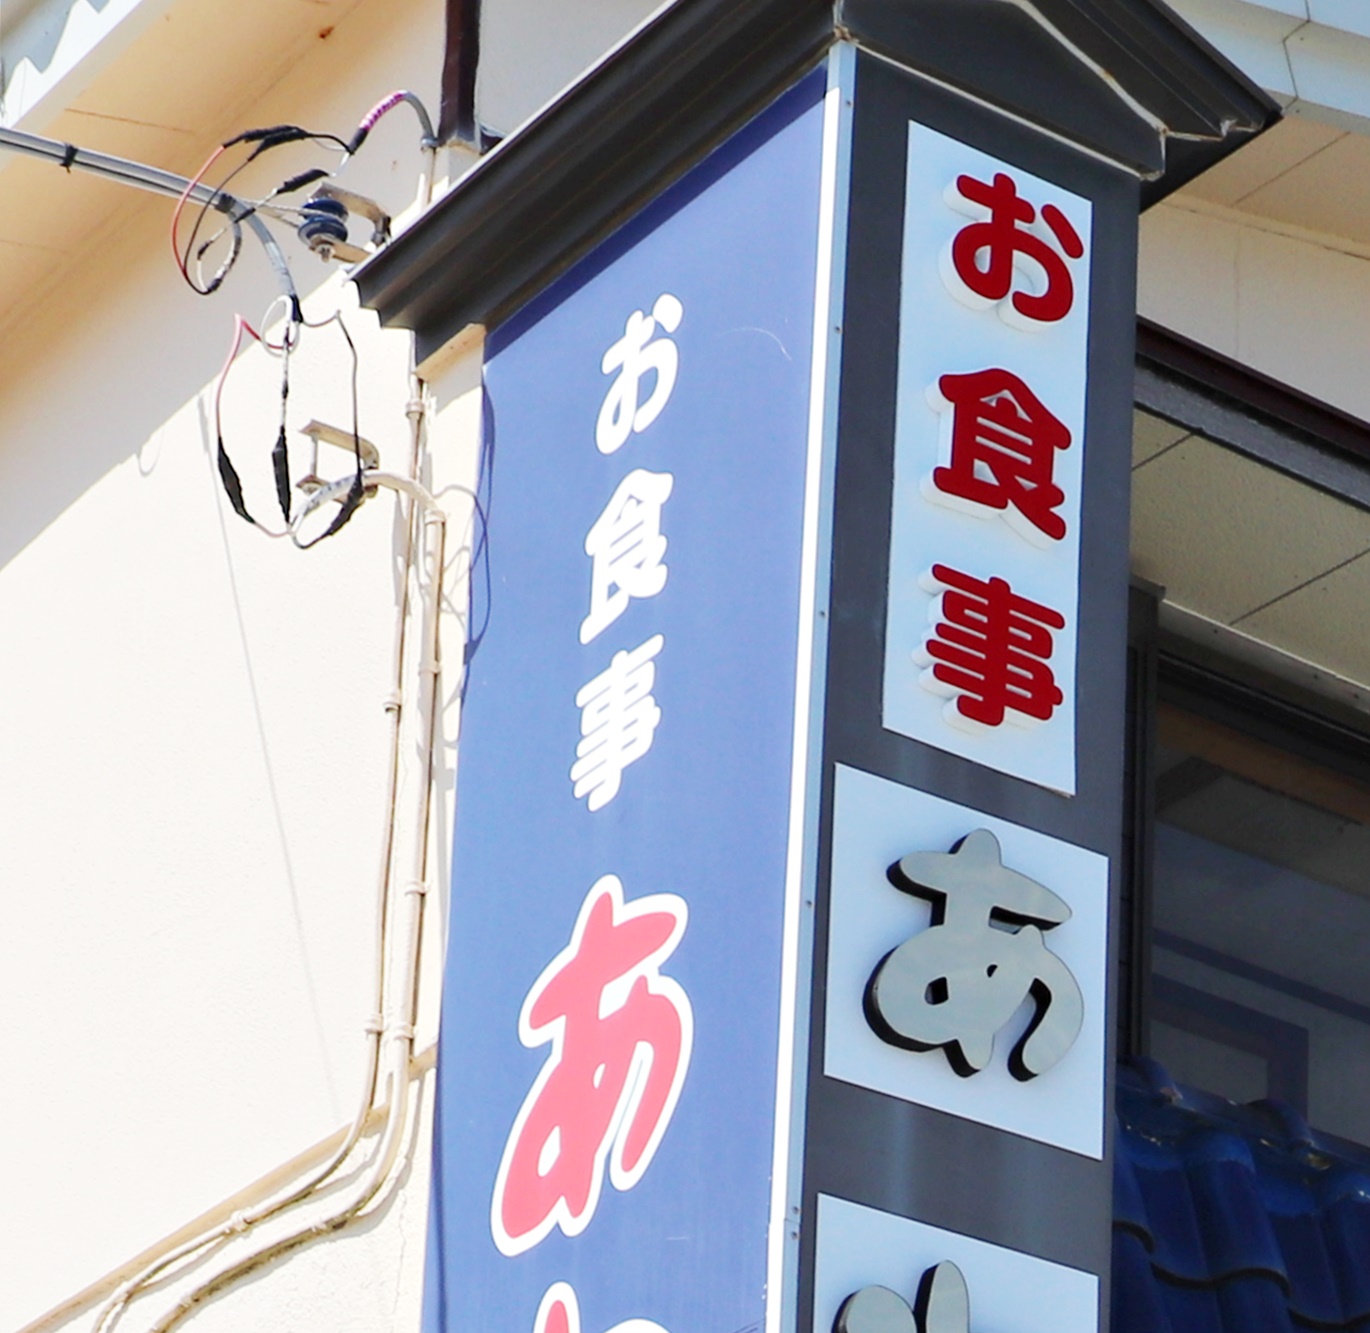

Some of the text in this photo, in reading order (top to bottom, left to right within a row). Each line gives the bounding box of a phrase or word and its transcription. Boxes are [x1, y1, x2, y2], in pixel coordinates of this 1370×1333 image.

[570, 293, 683, 812] お食事
[925, 171, 1084, 728] お食事
